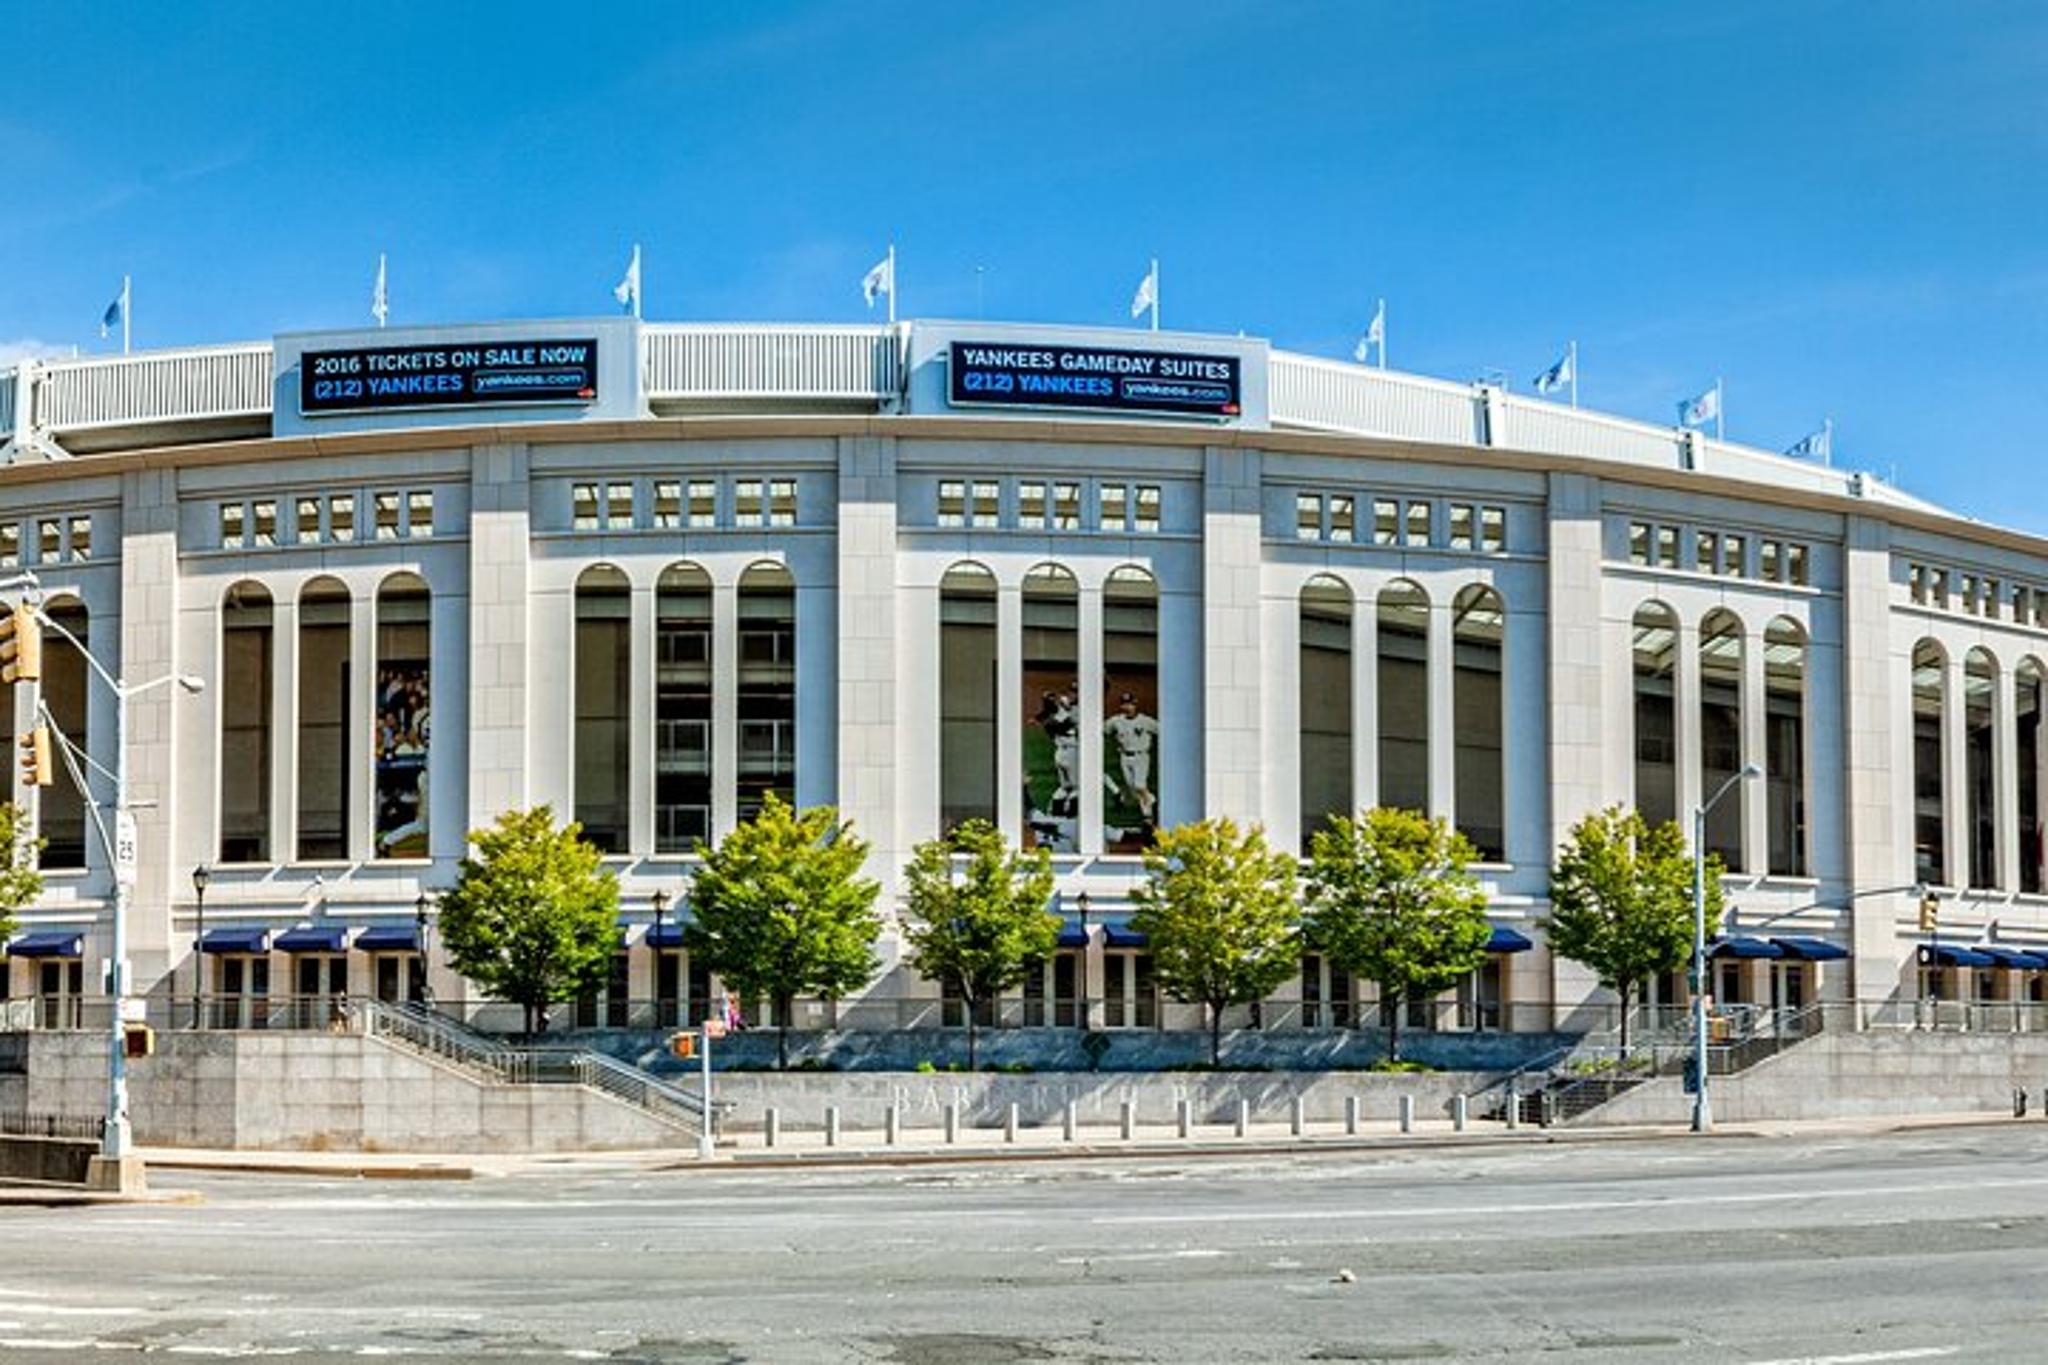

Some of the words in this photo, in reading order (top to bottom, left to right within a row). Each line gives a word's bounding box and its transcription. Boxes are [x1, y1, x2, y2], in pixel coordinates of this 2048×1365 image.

[314, 355, 361, 375] 2016
[366, 352, 448, 371] TICKETS
[451, 350, 479, 367] ON
[484, 348, 535, 366] SALE
[540, 346, 587, 364] NOW
[963, 349, 1055, 369] YANKEES
[1060, 352, 1155, 374] GAMEDAY
[1159, 358, 1230, 379] SUITES
[314, 379, 362, 399] (212)
[367, 374, 464, 395] YANKEES
[477, 373, 582, 391] yankees.com
[964, 372, 1013, 393] (212)
[1017, 373, 1113, 395] YANKEES
[1125, 382, 1227, 399] yankees.com
